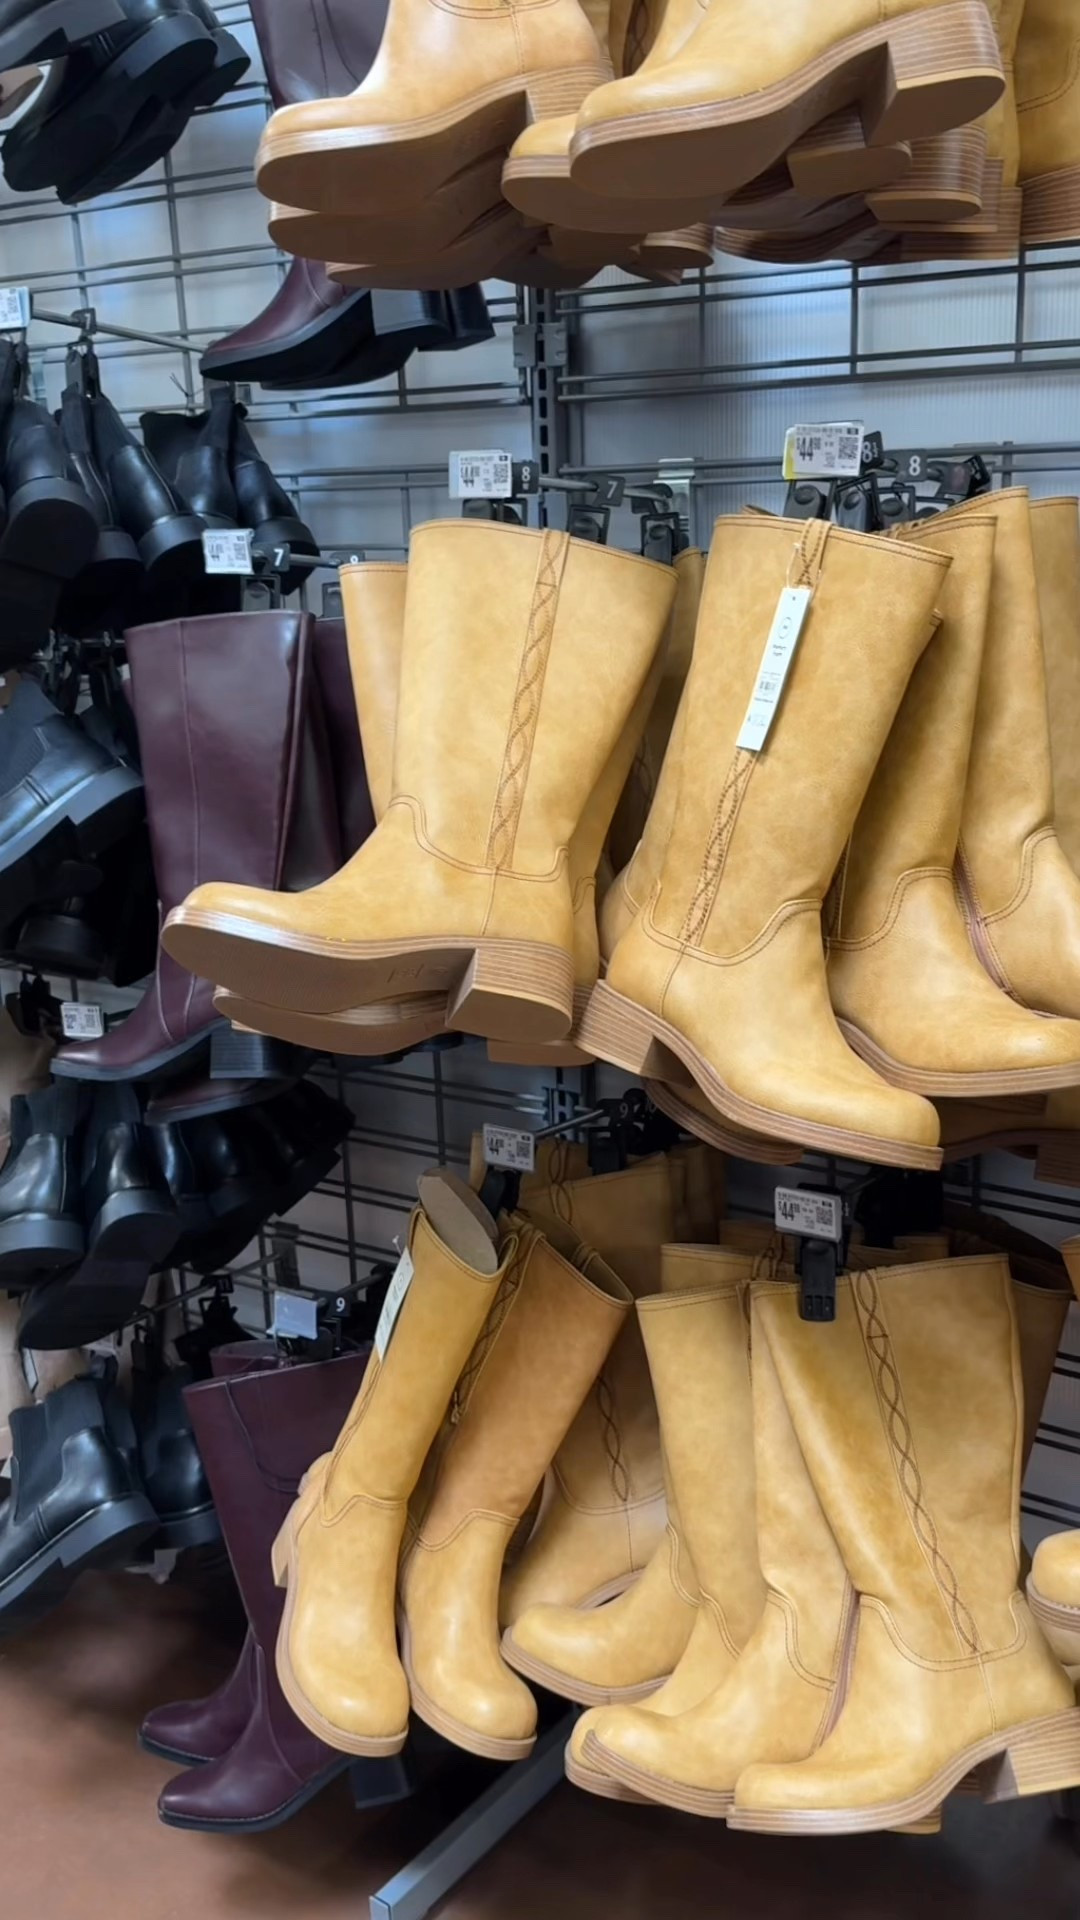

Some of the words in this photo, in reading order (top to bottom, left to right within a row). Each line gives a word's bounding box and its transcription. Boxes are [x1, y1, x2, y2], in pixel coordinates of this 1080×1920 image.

[522, 466, 530, 482] 8
[909, 456, 920, 476] 8
[607, 481, 618, 499] 7
[274, 548, 284, 566] 7
[620, 1102, 629, 1118] 9
[336, 1297, 346, 1312] 9
